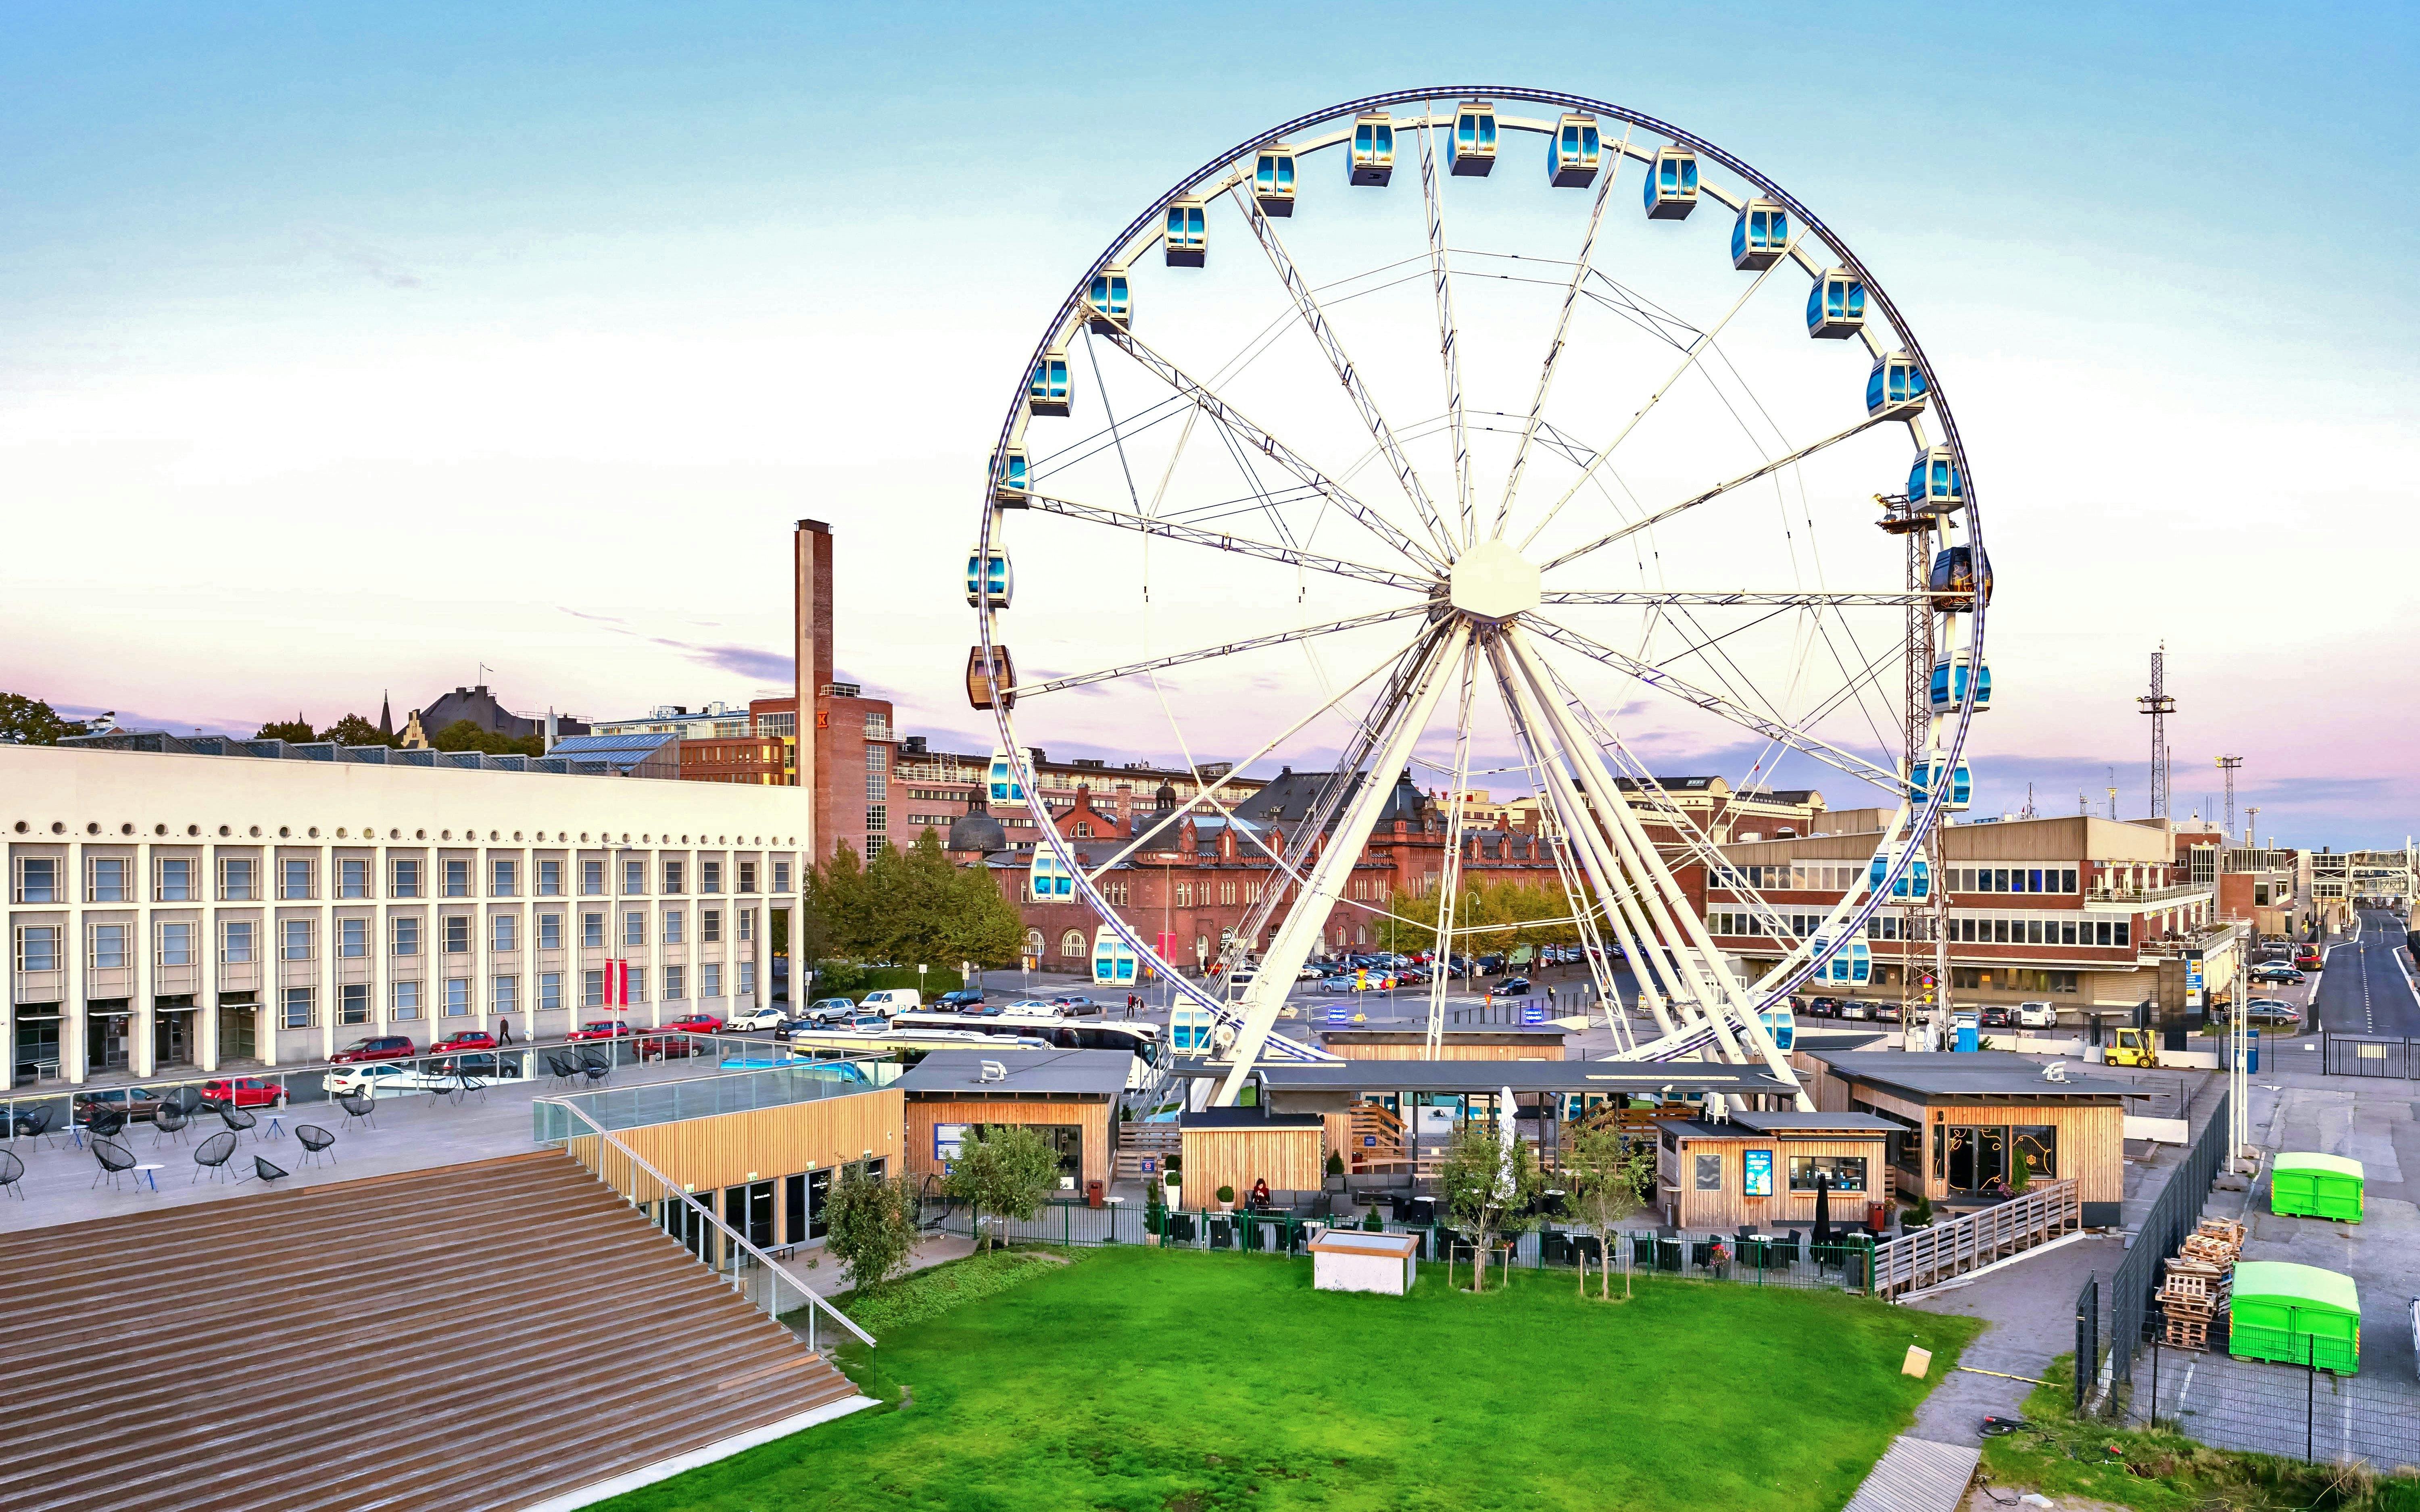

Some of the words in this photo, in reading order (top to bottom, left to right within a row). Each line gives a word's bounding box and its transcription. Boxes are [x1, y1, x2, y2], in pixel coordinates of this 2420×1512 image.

[818, 714, 826, 725] K
[2170, 824, 2182, 832] ER
[2181, 952, 2187, 960] A
[899, 1005, 905, 1013] P
